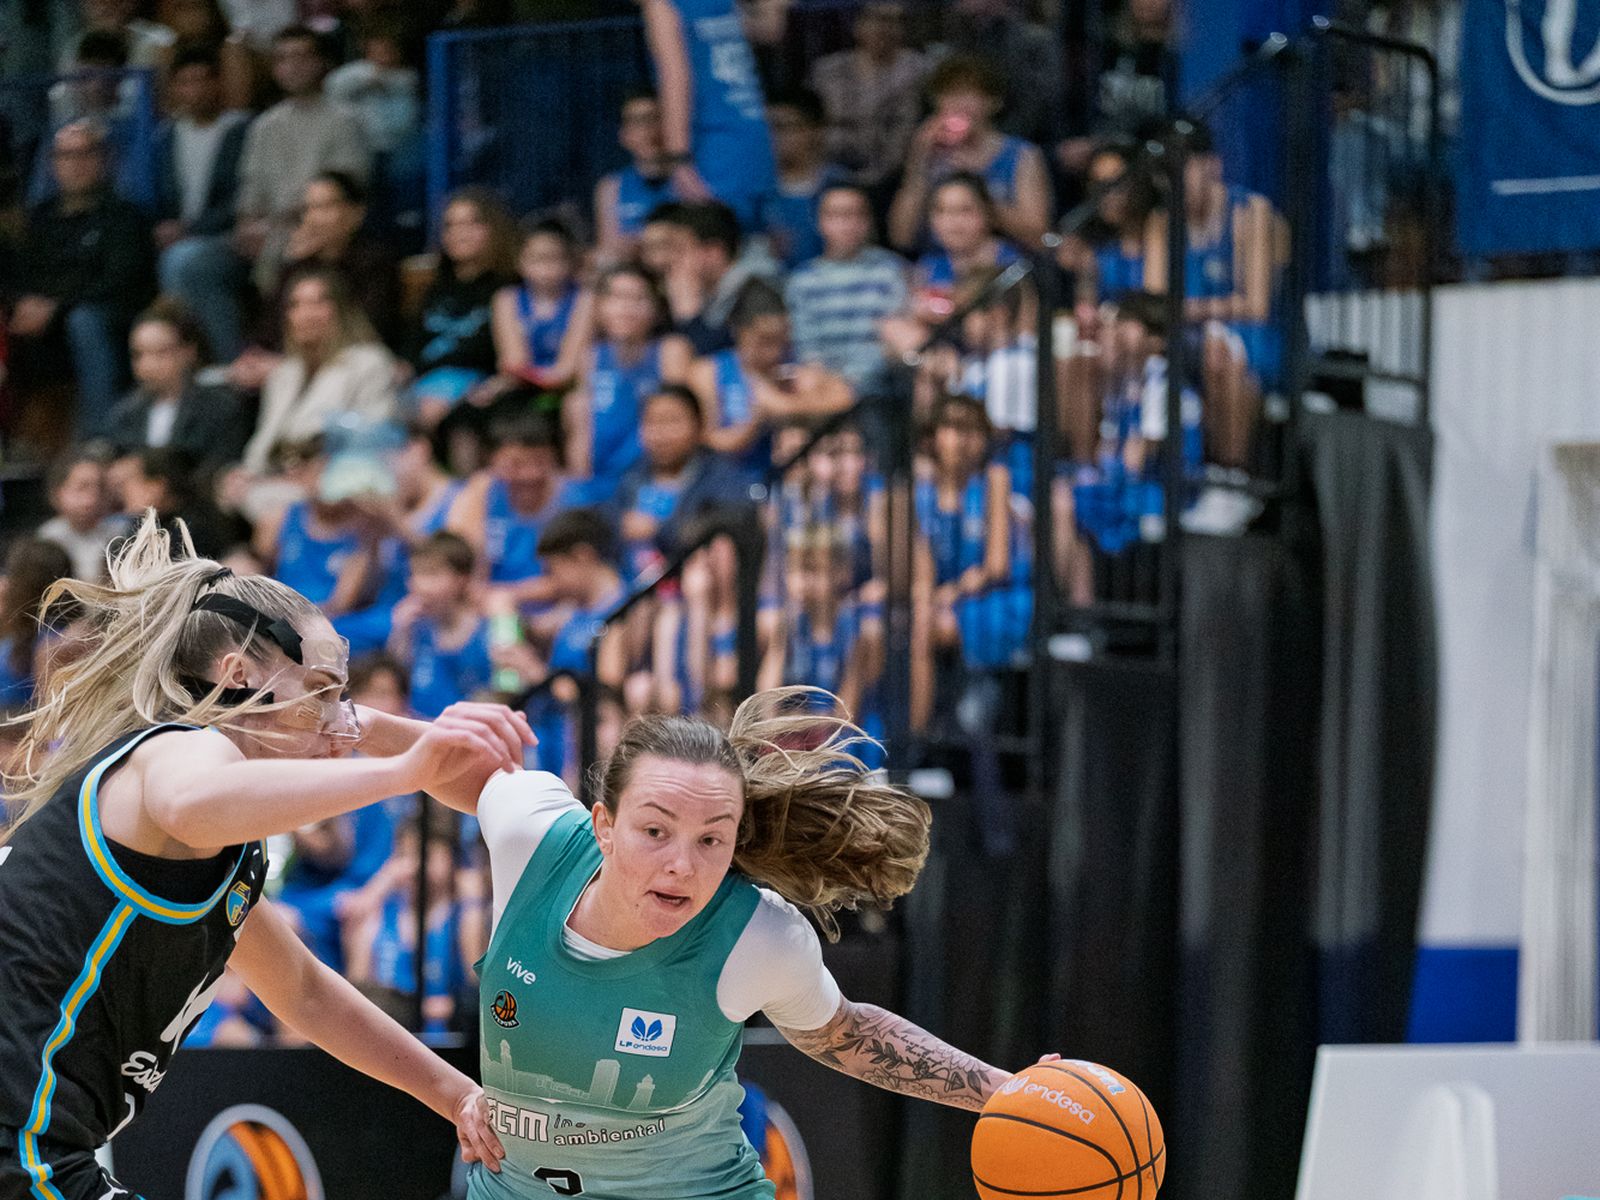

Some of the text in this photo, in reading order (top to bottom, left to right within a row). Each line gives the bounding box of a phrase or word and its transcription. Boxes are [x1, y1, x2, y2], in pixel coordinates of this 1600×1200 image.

[506, 956, 536, 985] vive
[1023, 1082, 1095, 1125] endesa
[553, 1117, 666, 1147] ambiental
